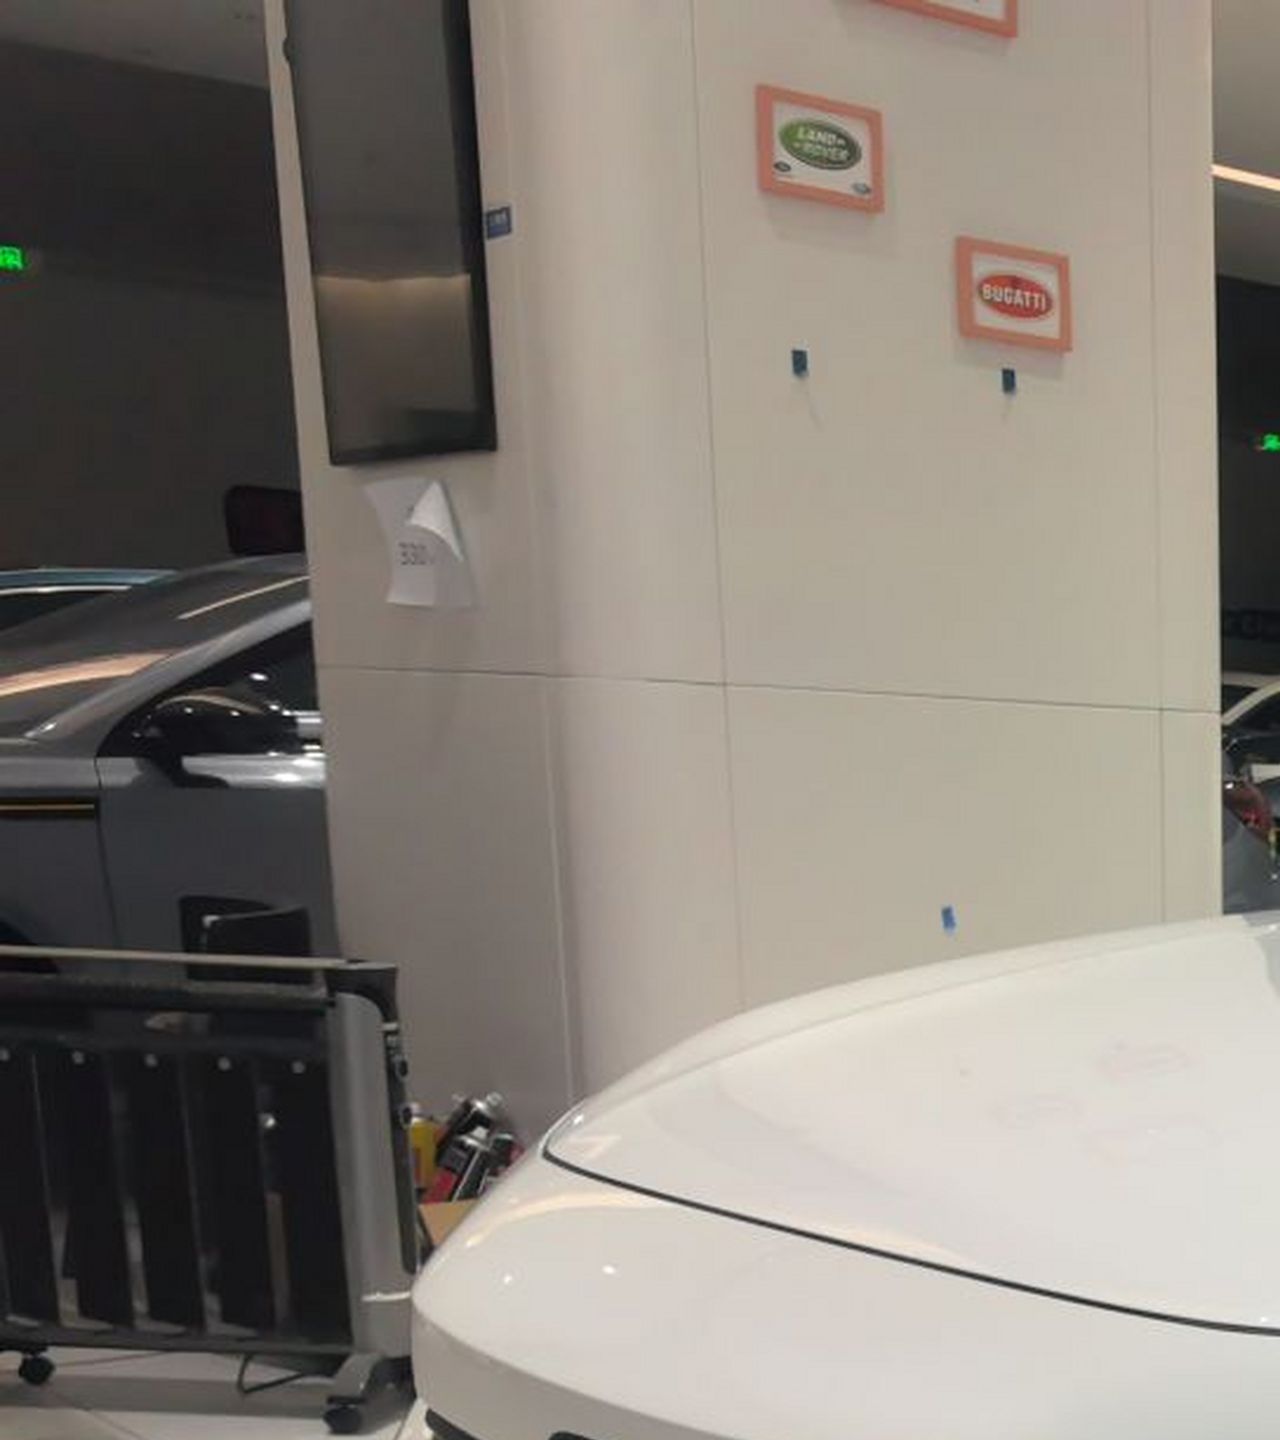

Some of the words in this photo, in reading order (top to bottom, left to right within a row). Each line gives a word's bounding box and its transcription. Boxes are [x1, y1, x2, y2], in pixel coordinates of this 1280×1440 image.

[798, 126, 837, 146] LAND
[802, 141, 850, 161] ROVER
[982, 283, 1047, 312] BUGATTI
